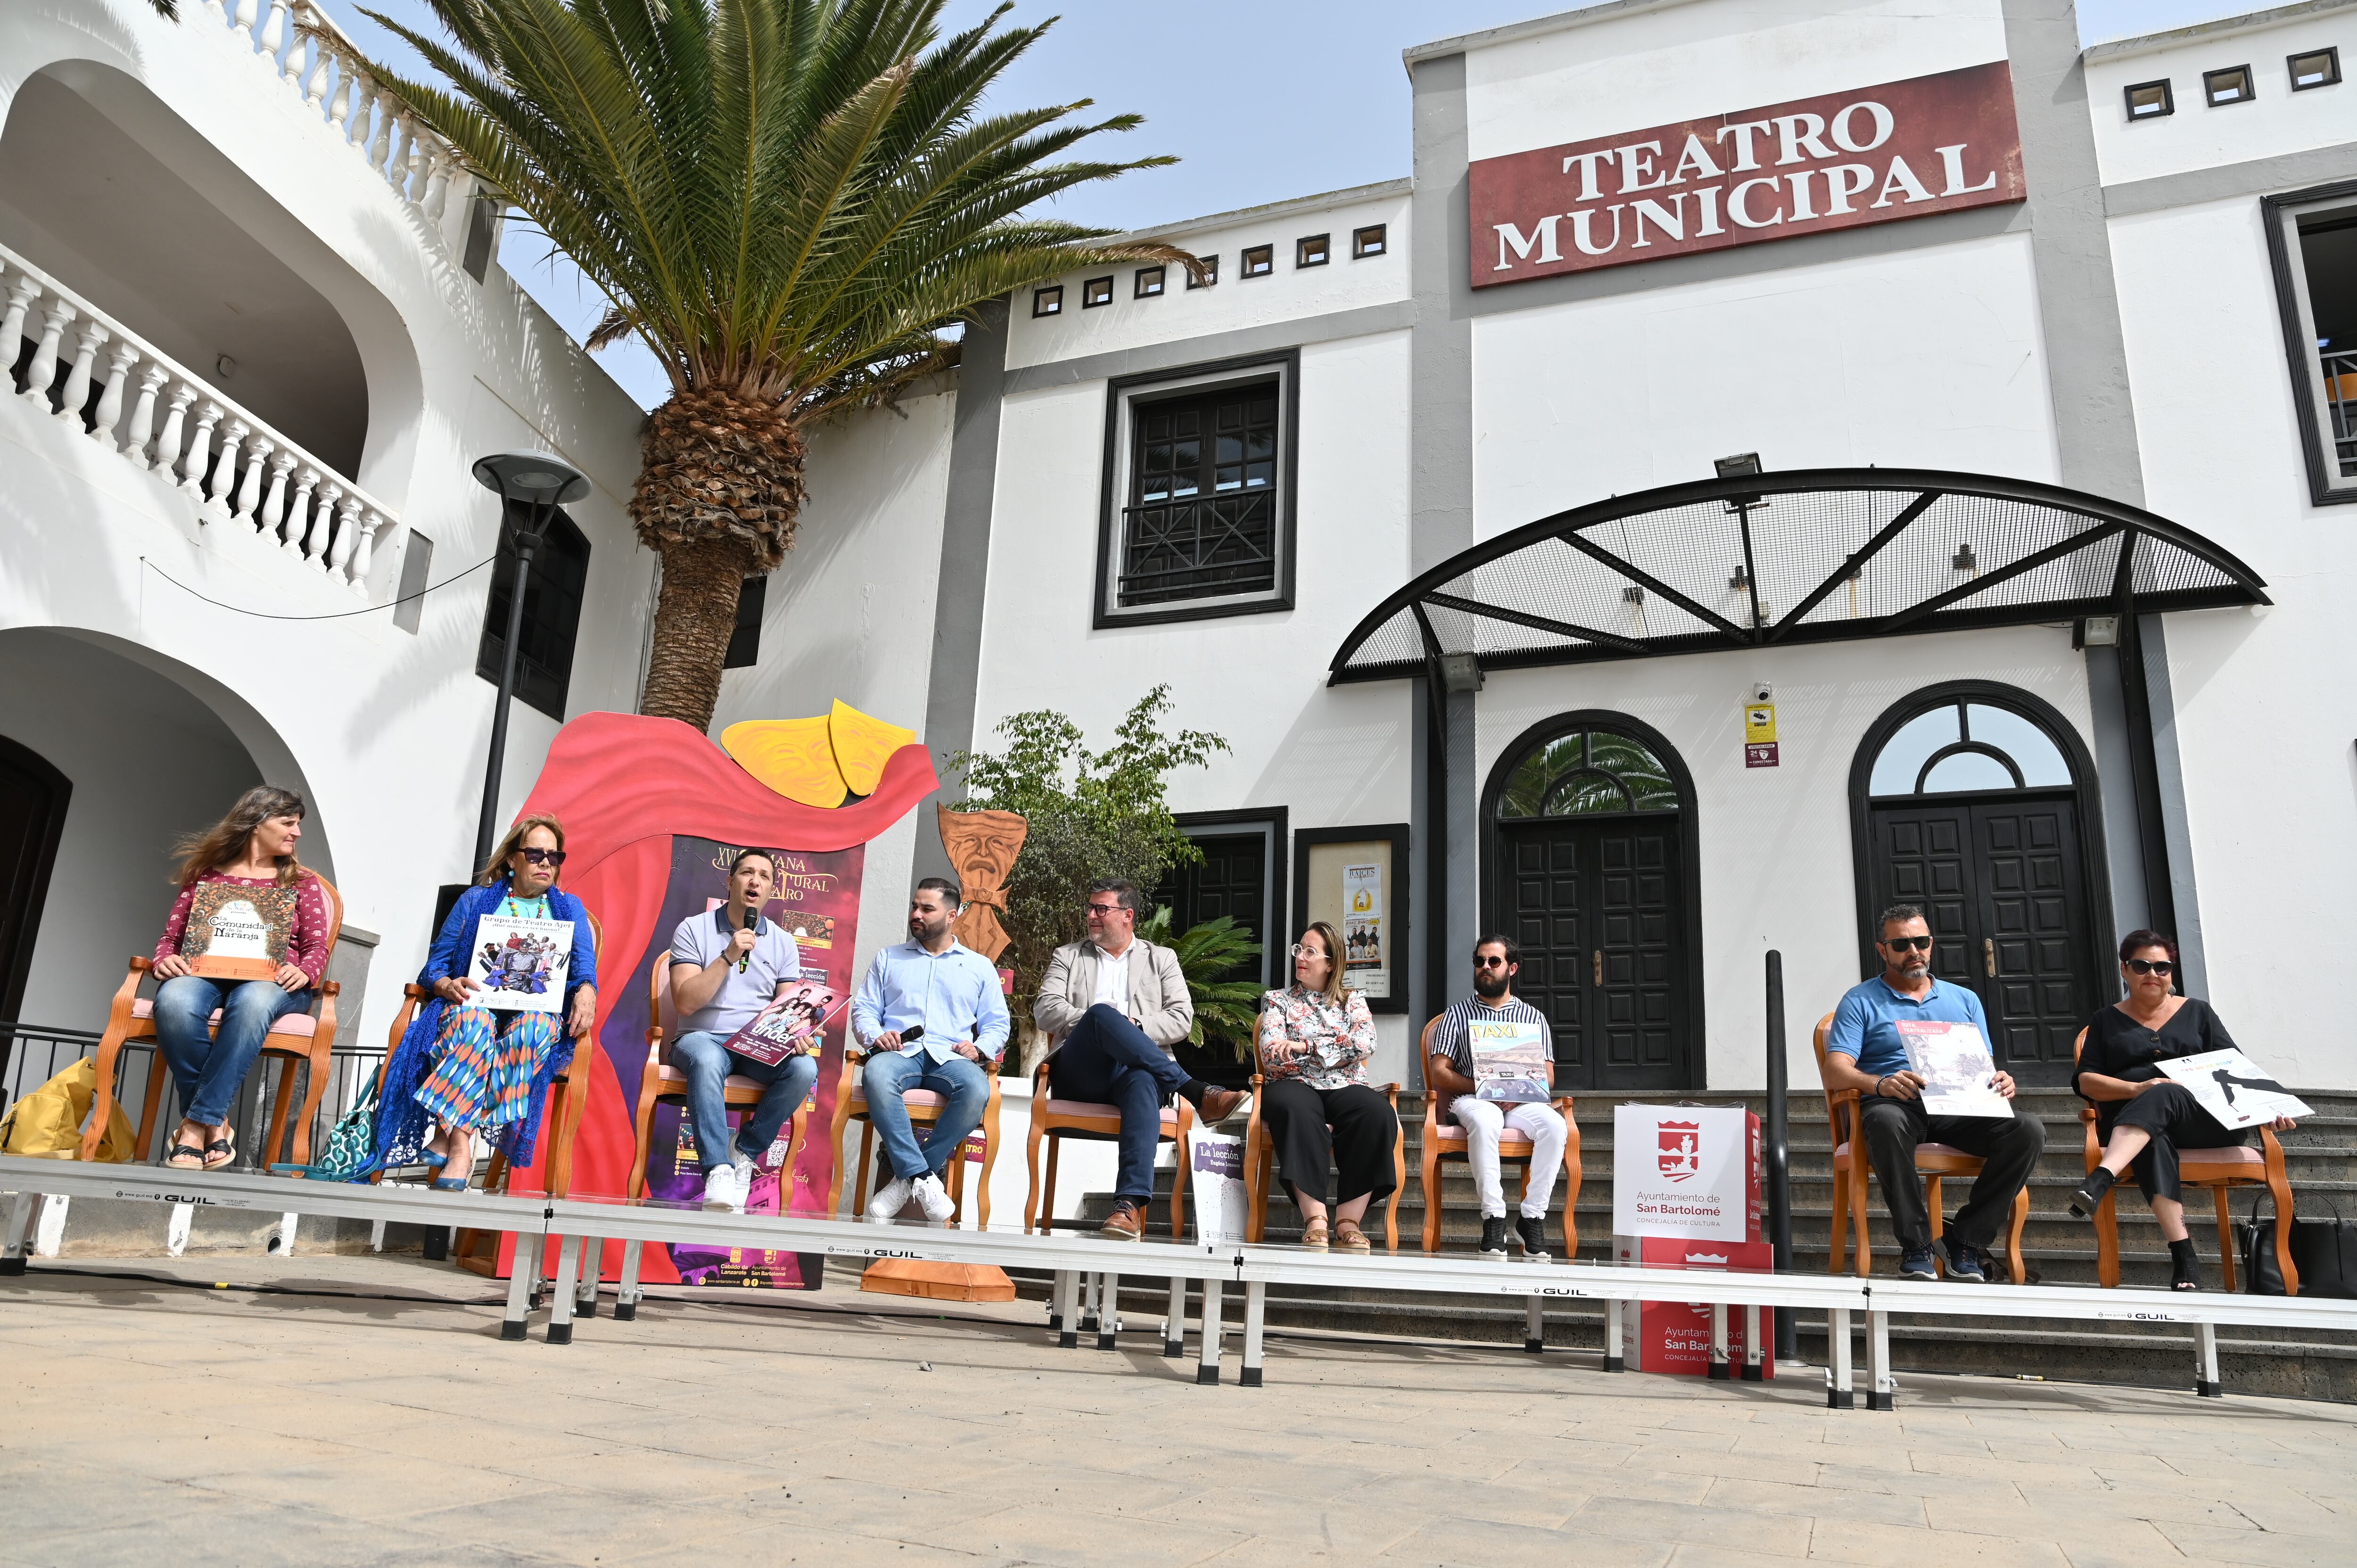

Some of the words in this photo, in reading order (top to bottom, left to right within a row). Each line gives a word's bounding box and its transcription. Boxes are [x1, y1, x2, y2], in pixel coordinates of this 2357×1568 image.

[1562, 101, 1894, 202] TEATRO
[1493, 144, 1996, 271] MUNICIPAL
[210, 917, 272, 930] Comunidad
[214, 928, 259, 940] Naranja
[806, 972, 825, 980] lección
[751, 1022, 797, 1044] tinder
[1469, 1024, 1518, 1038] TAXI
[1200, 1146, 1211, 1157] La
[1213, 1147, 1239, 1160] lección
[165, 1195, 216, 1205] GUIL
[1636, 1191, 1705, 1203] Ayuntamiento
[1707, 1194, 1720, 1203] de
[1637, 1203, 1657, 1213] San
[1660, 1205, 1721, 1216] Bartolomé
[1636, 1217, 1678, 1225] CONCEJALÍA
[874, 1249, 923, 1259] GUIL
[1665, 1339, 1686, 1350] San
[1665, 1353, 1707, 1362] CONCEJALÍA
